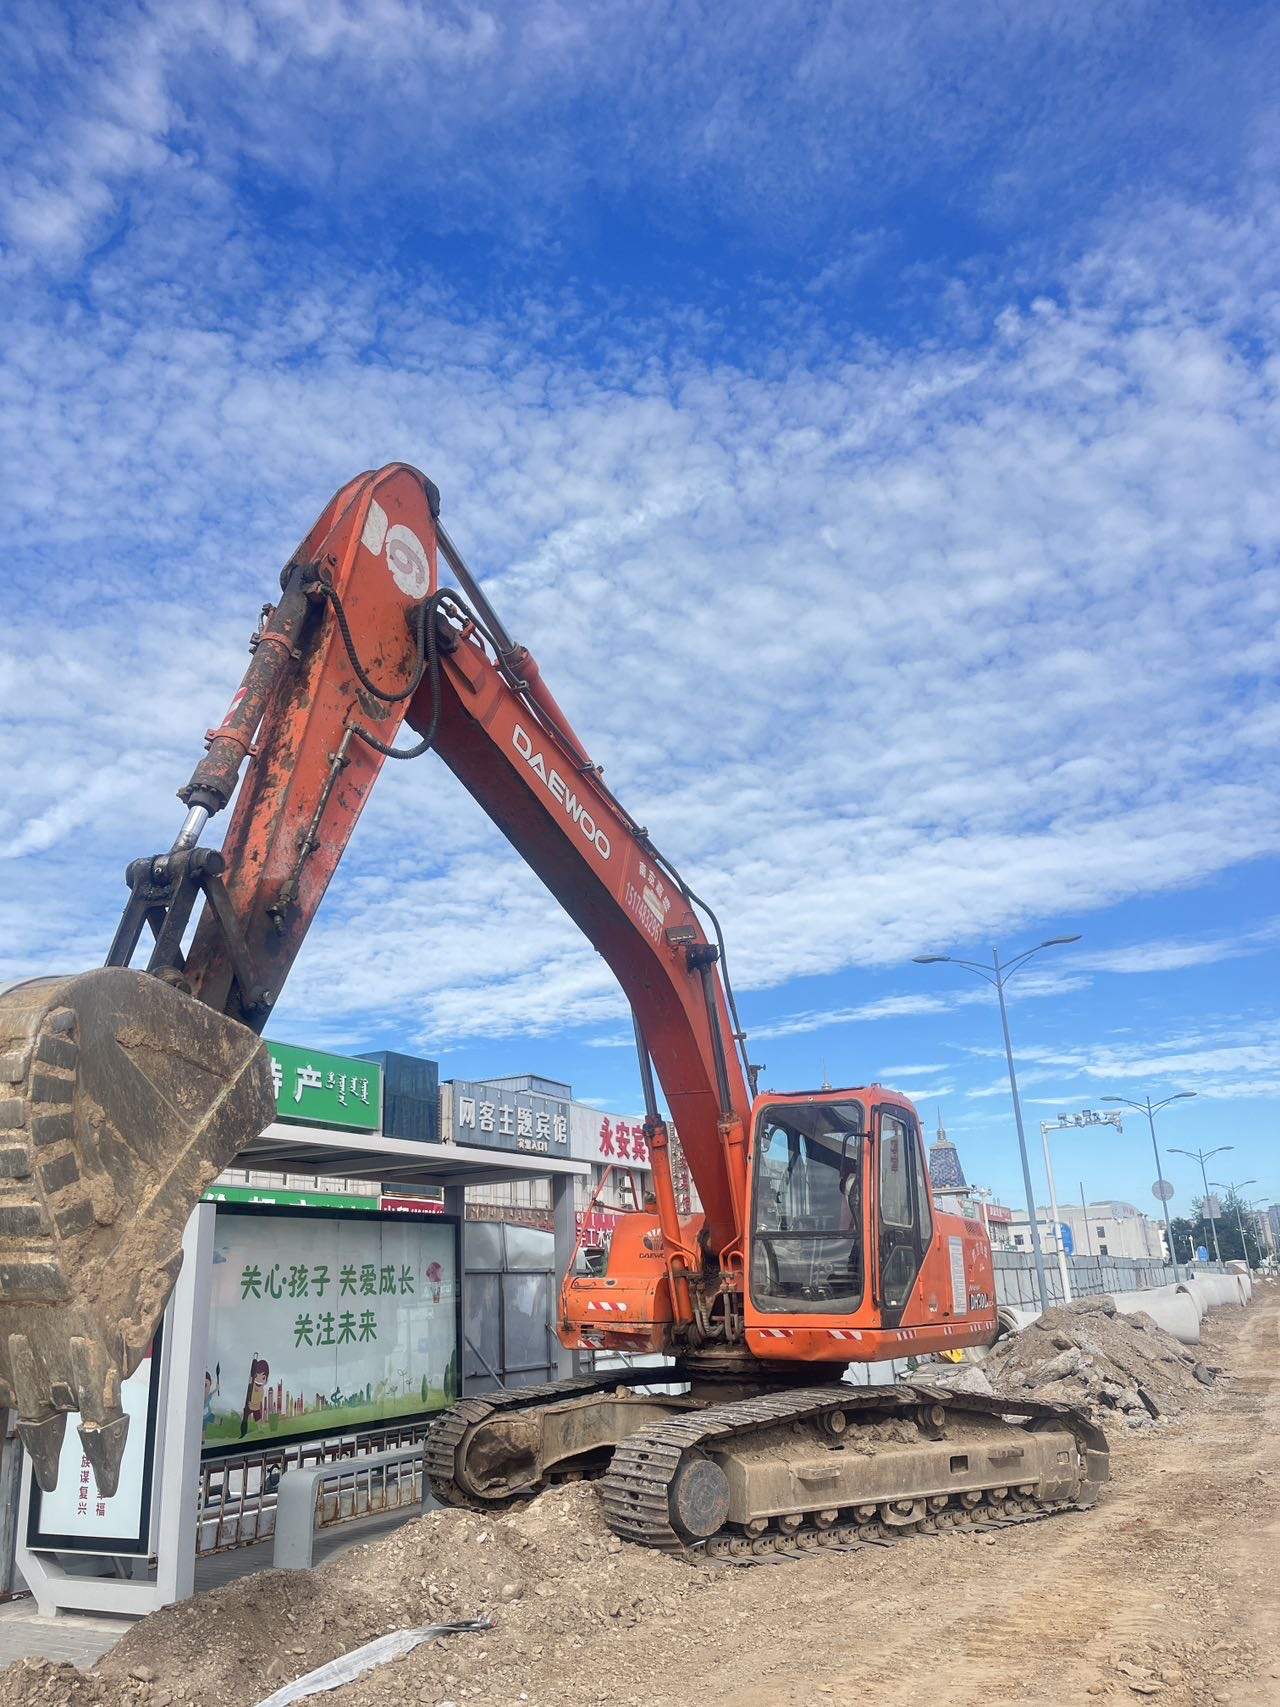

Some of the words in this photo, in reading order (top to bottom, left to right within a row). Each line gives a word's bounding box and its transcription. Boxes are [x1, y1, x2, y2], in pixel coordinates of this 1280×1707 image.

[512, 722, 611, 862] DAEWOO
[459, 1096, 567, 1144] 网客主题宾馆
[240, 1265, 331, 1300] 关心孩子
[339, 1263, 415, 1297] 关爱成长
[293, 1309, 378, 1348] 关注未来
